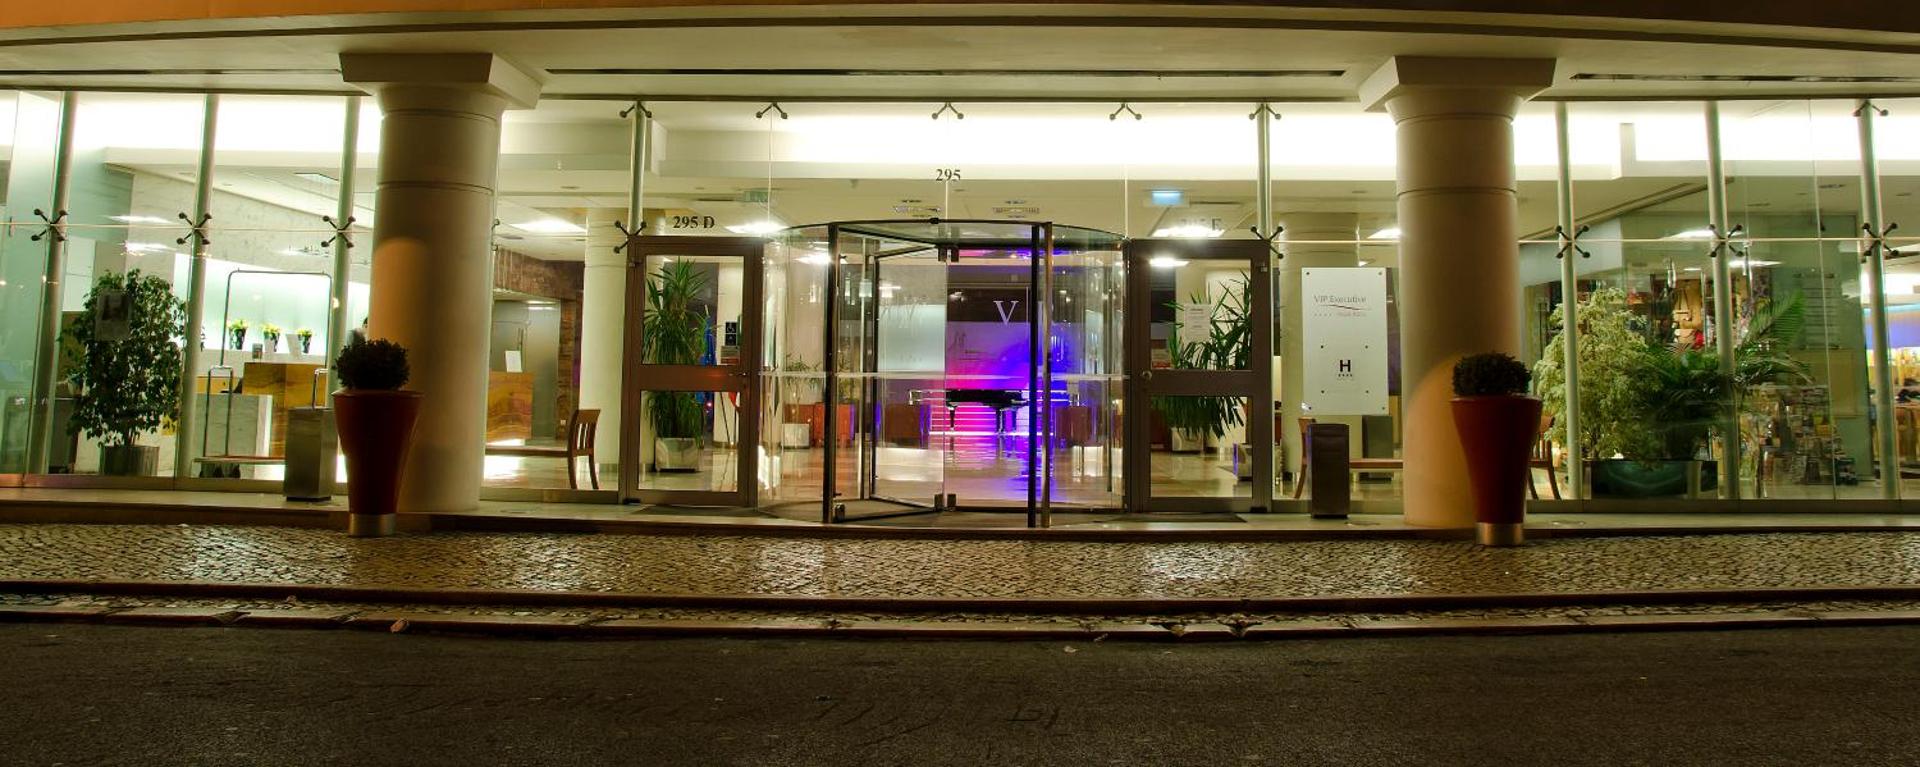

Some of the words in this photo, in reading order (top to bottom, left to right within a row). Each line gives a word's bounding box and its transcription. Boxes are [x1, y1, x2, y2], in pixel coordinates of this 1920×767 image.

[936, 169, 961, 182] 295
[673, 216, 698, 228] 295
[703, 216, 715, 228] D
[1313, 295, 1328, 304] VIP
[1329, 295, 1367, 304] Executive
[993, 300, 1019, 325] V
[1339, 359, 1351, 372] H
